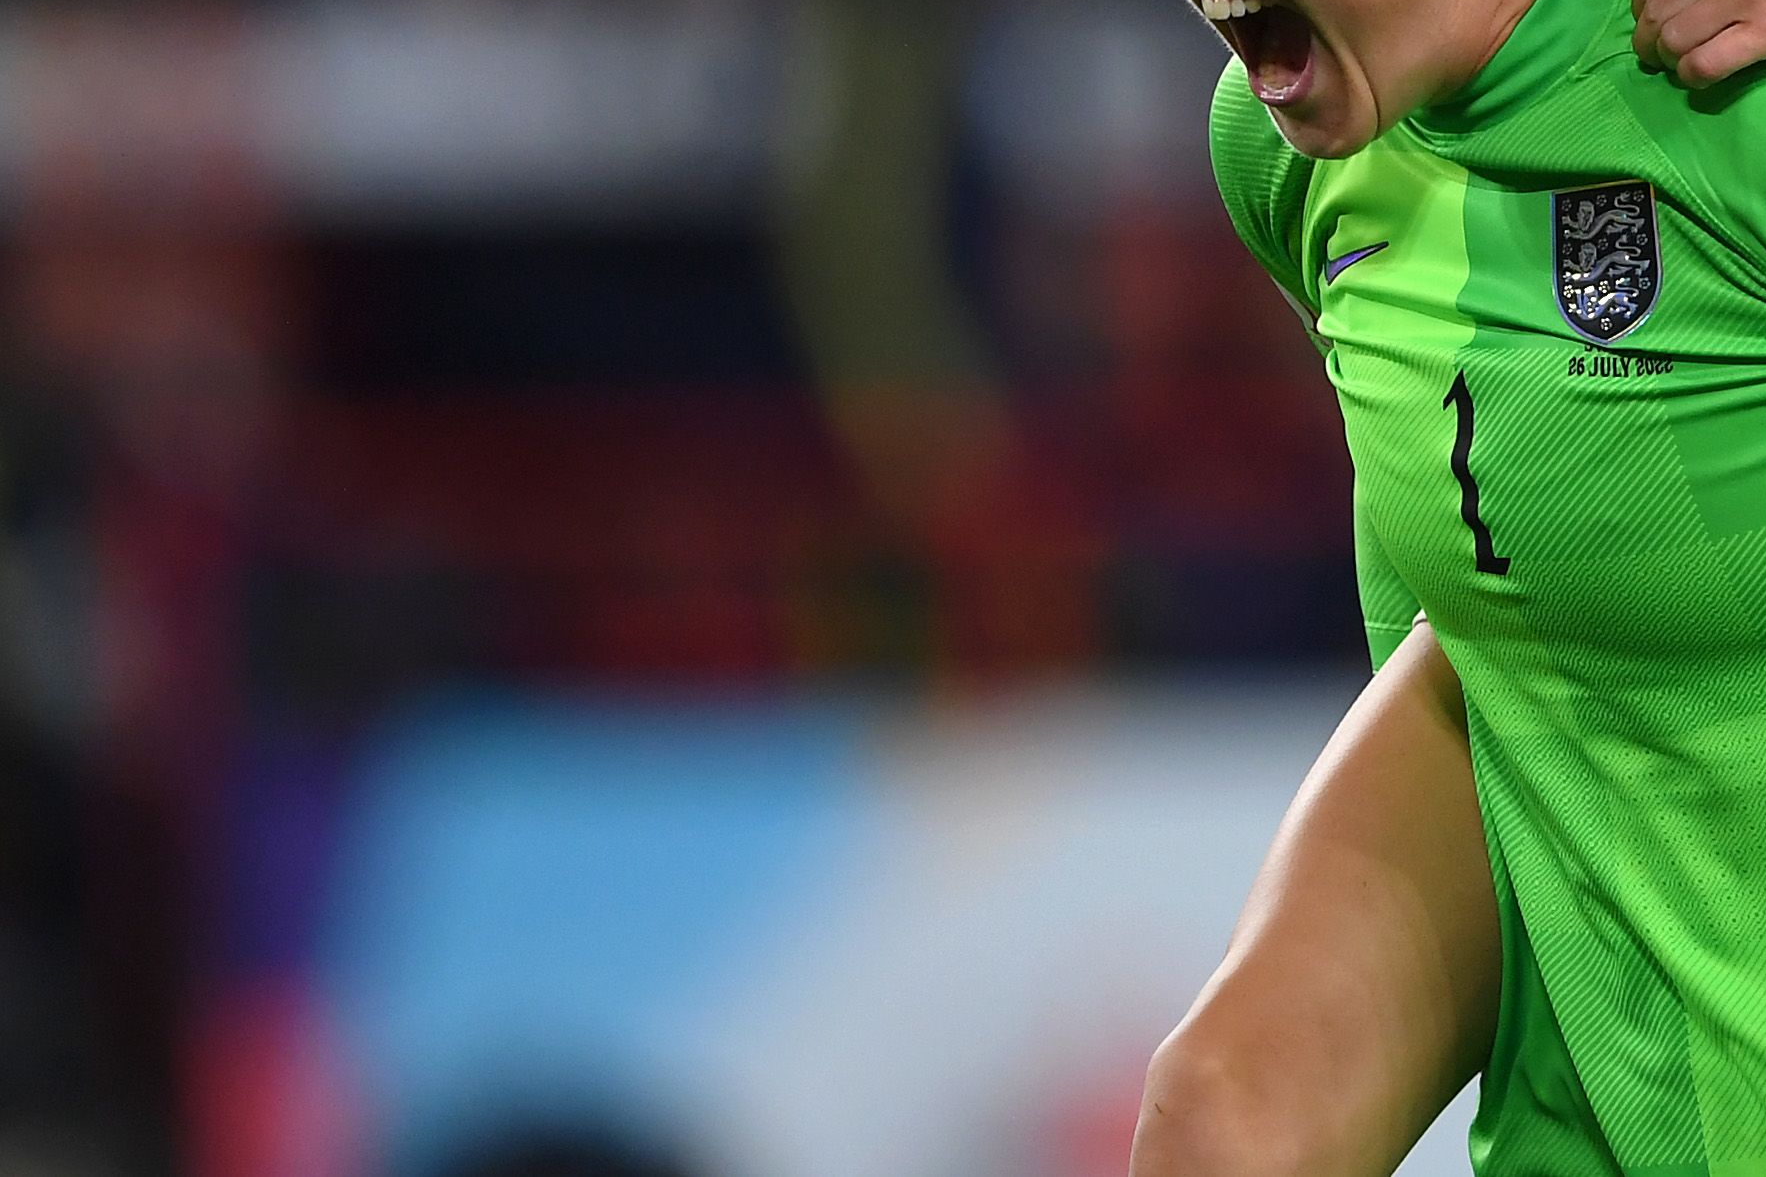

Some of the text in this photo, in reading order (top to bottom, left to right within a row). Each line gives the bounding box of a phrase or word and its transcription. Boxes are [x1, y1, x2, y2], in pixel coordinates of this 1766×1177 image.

[1567, 356, 1585, 376] 26
[1588, 356, 1630, 378] JULY
[1442, 368, 1511, 575] 1
